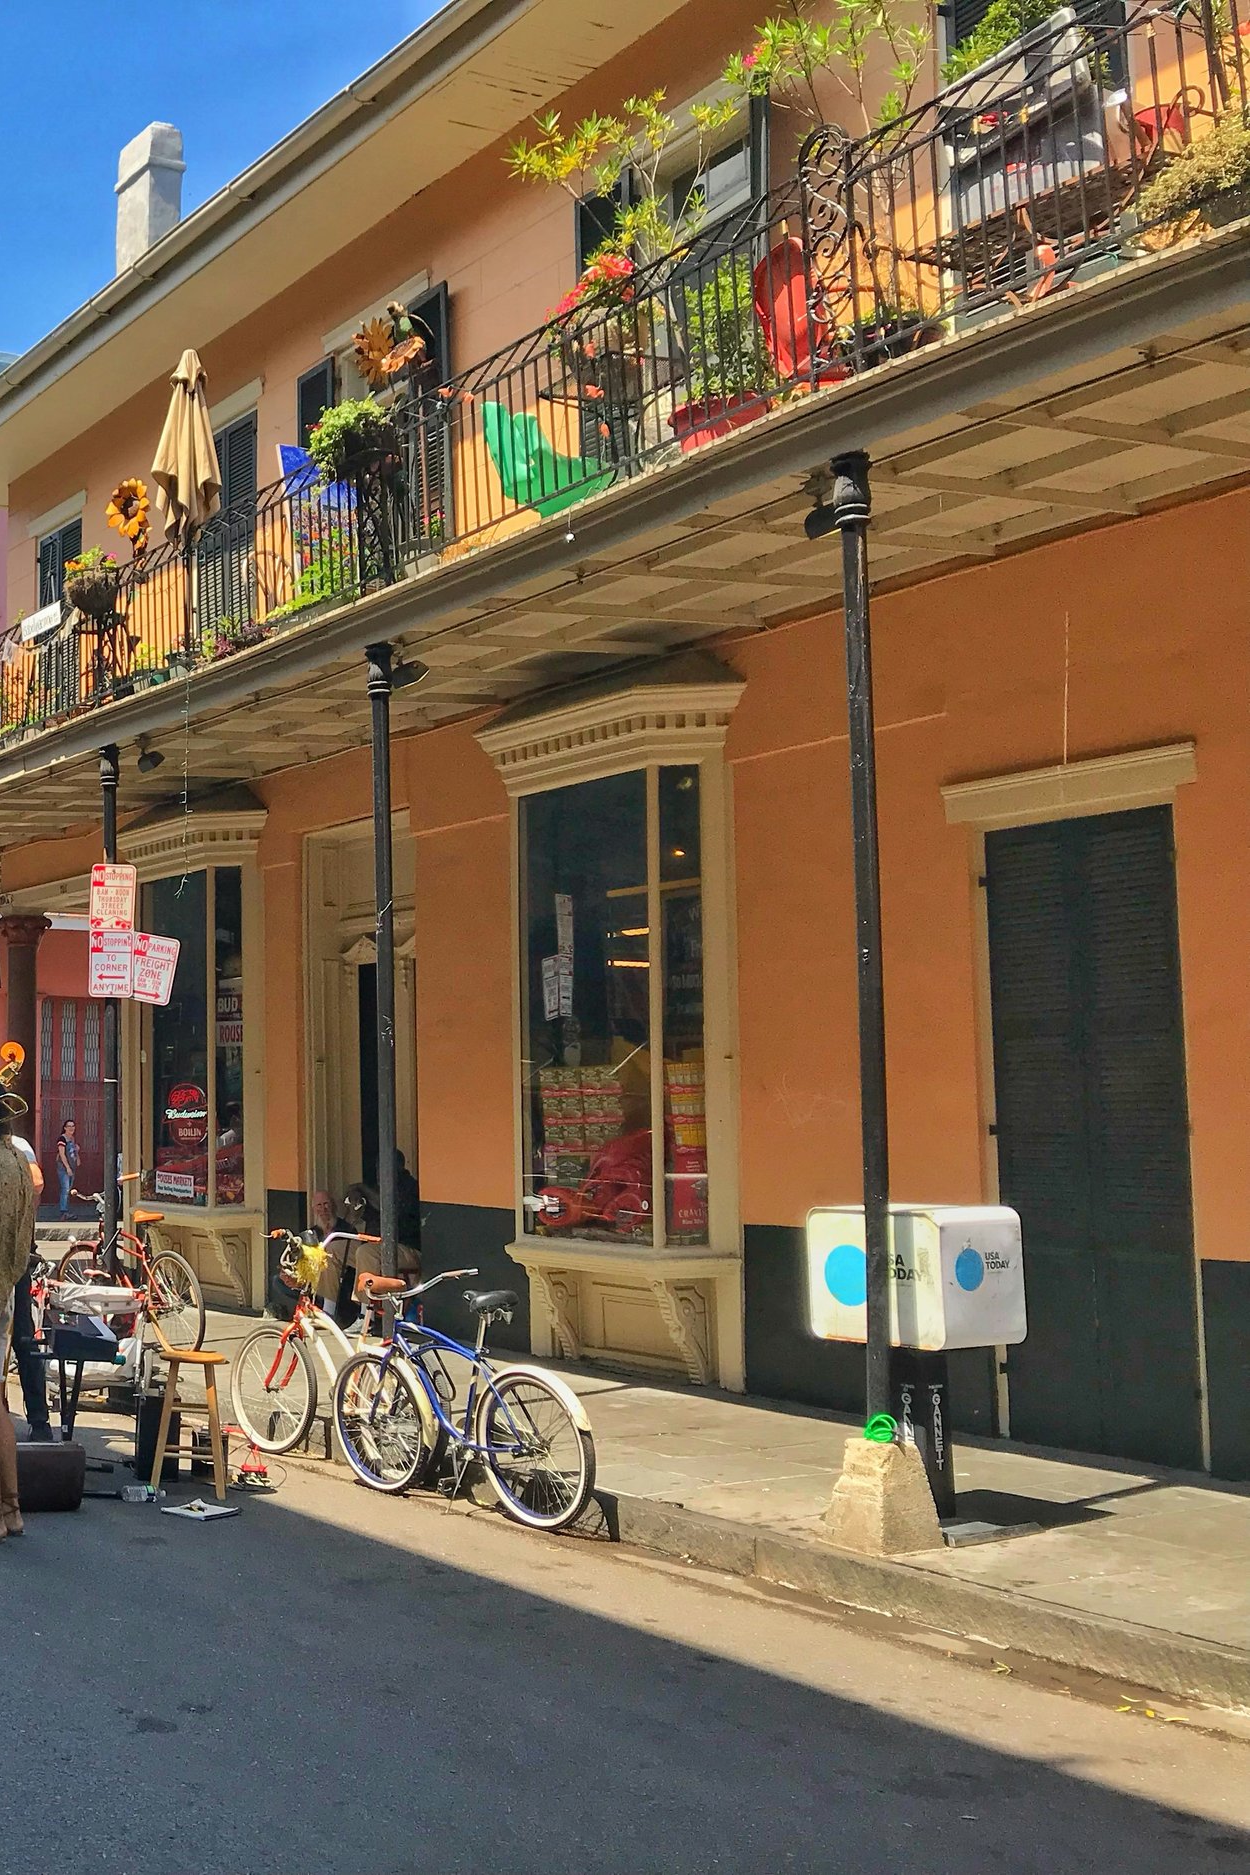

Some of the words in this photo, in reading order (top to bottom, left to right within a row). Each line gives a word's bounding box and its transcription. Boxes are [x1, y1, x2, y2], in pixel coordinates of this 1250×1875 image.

[93, 869, 105, 882] NO
[105, 872, 132, 881] STOPPING
[98, 895, 127, 903] THURSDAY
[101, 902, 124, 910] STREET
[91, 936, 104, 949] NO
[135, 938, 148, 952] NO
[147, 942, 177, 956] PARKING
[94, 963, 128, 972] CORNER
[135, 957, 171, 971] FREIGHT
[139, 968, 162, 980] ZONE
[92, 984, 129, 992] ANYTIME
[984, 1251, 1000, 1260] USA
[985, 1259, 1010, 1270] TODAY
[932, 1393, 945, 1471] GANNETT
